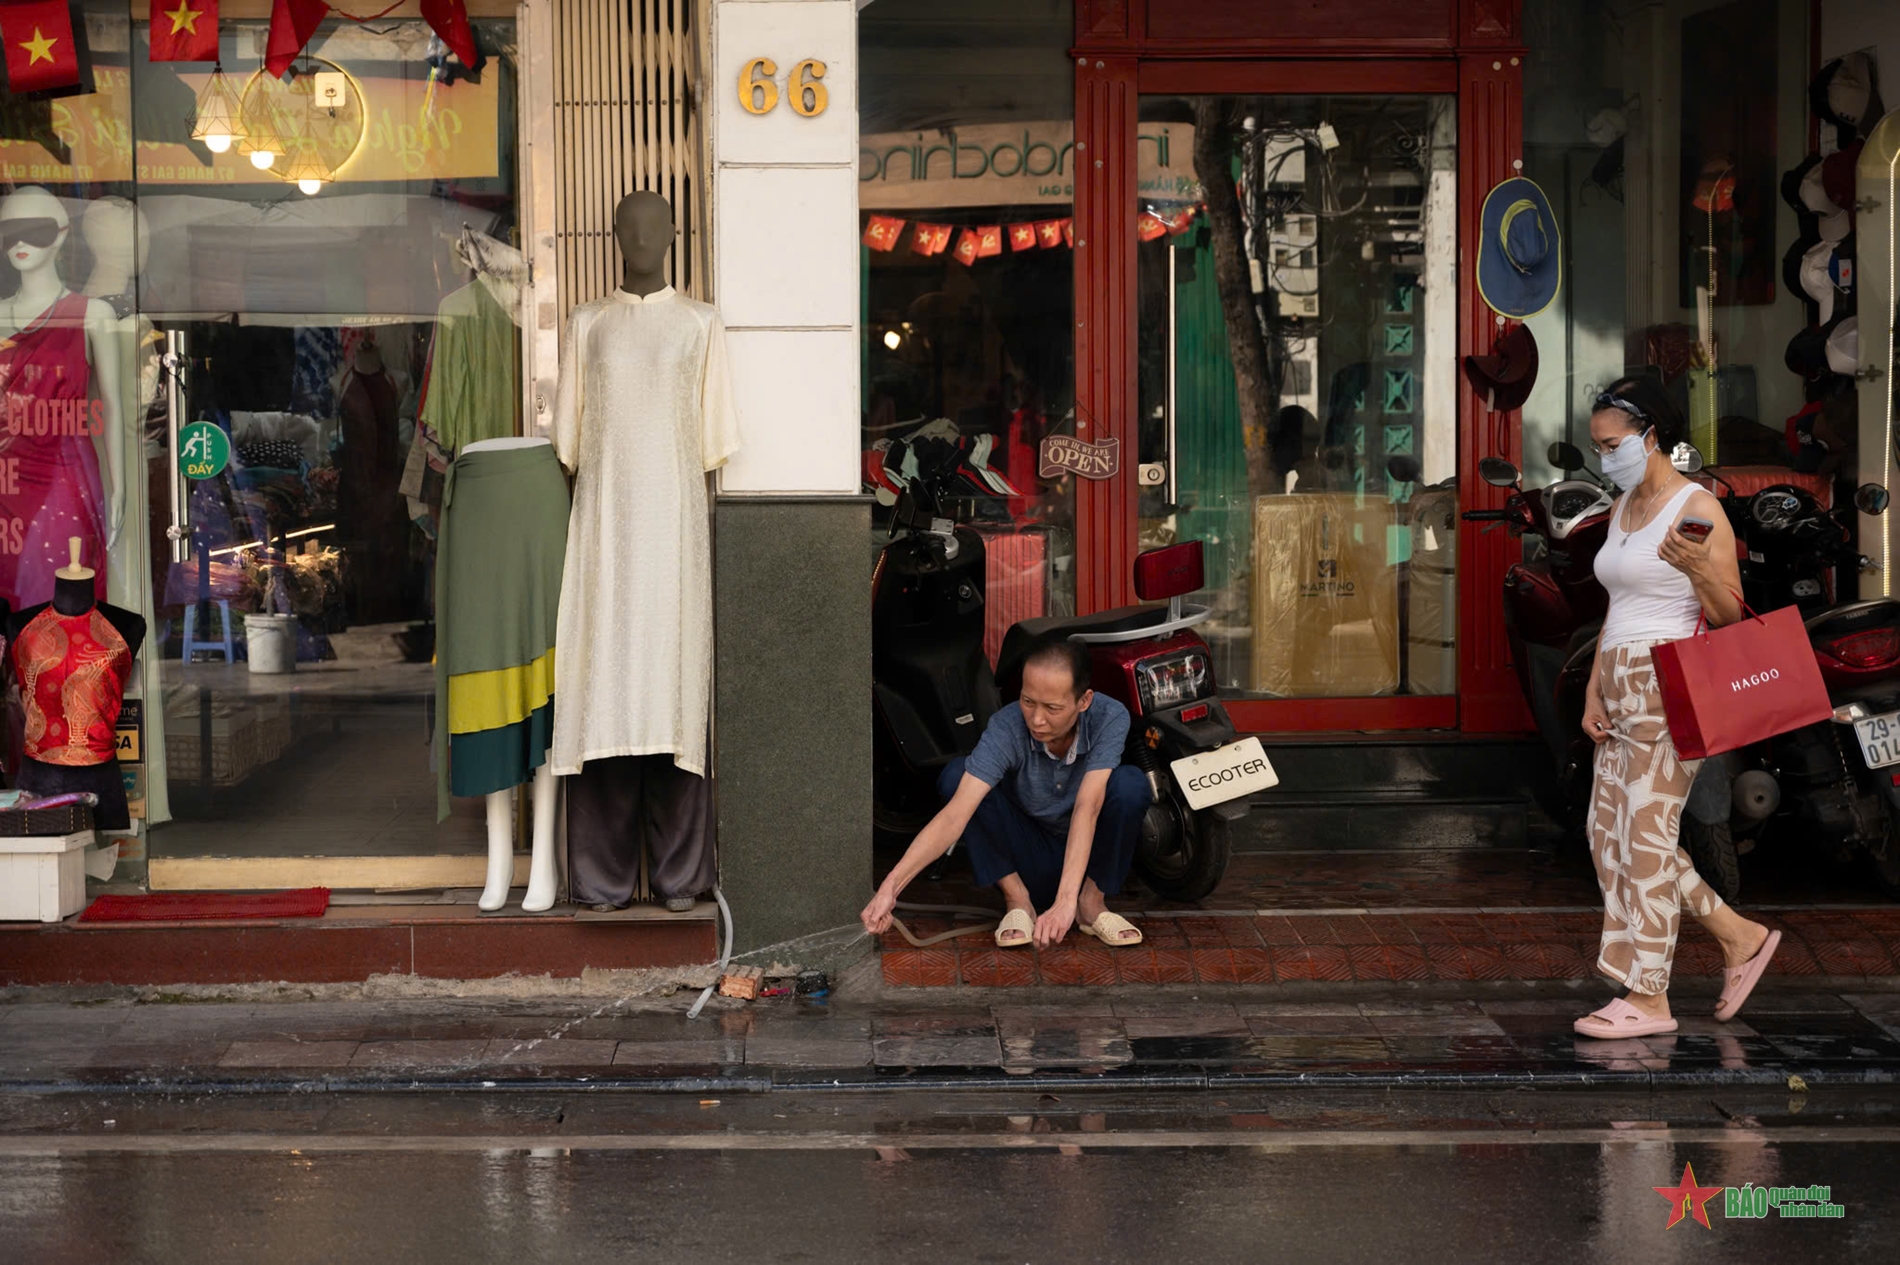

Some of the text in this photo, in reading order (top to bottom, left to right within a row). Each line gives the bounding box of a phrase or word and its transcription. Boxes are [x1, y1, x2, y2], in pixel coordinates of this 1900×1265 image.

[737, 57, 829, 117] 66
[8, 399, 104, 437] CLOTHES
[1048, 446, 1111, 474] OPEN
[1049, 439, 1069, 448] COME
[1082, 446, 1093, 456] WE
[1094, 448, 1110, 457] ARE
[1300, 581, 1355, 592] MARTINO
[1731, 667, 1780, 692] HAGOO
[1188, 758, 1267, 792] ECOOTER
